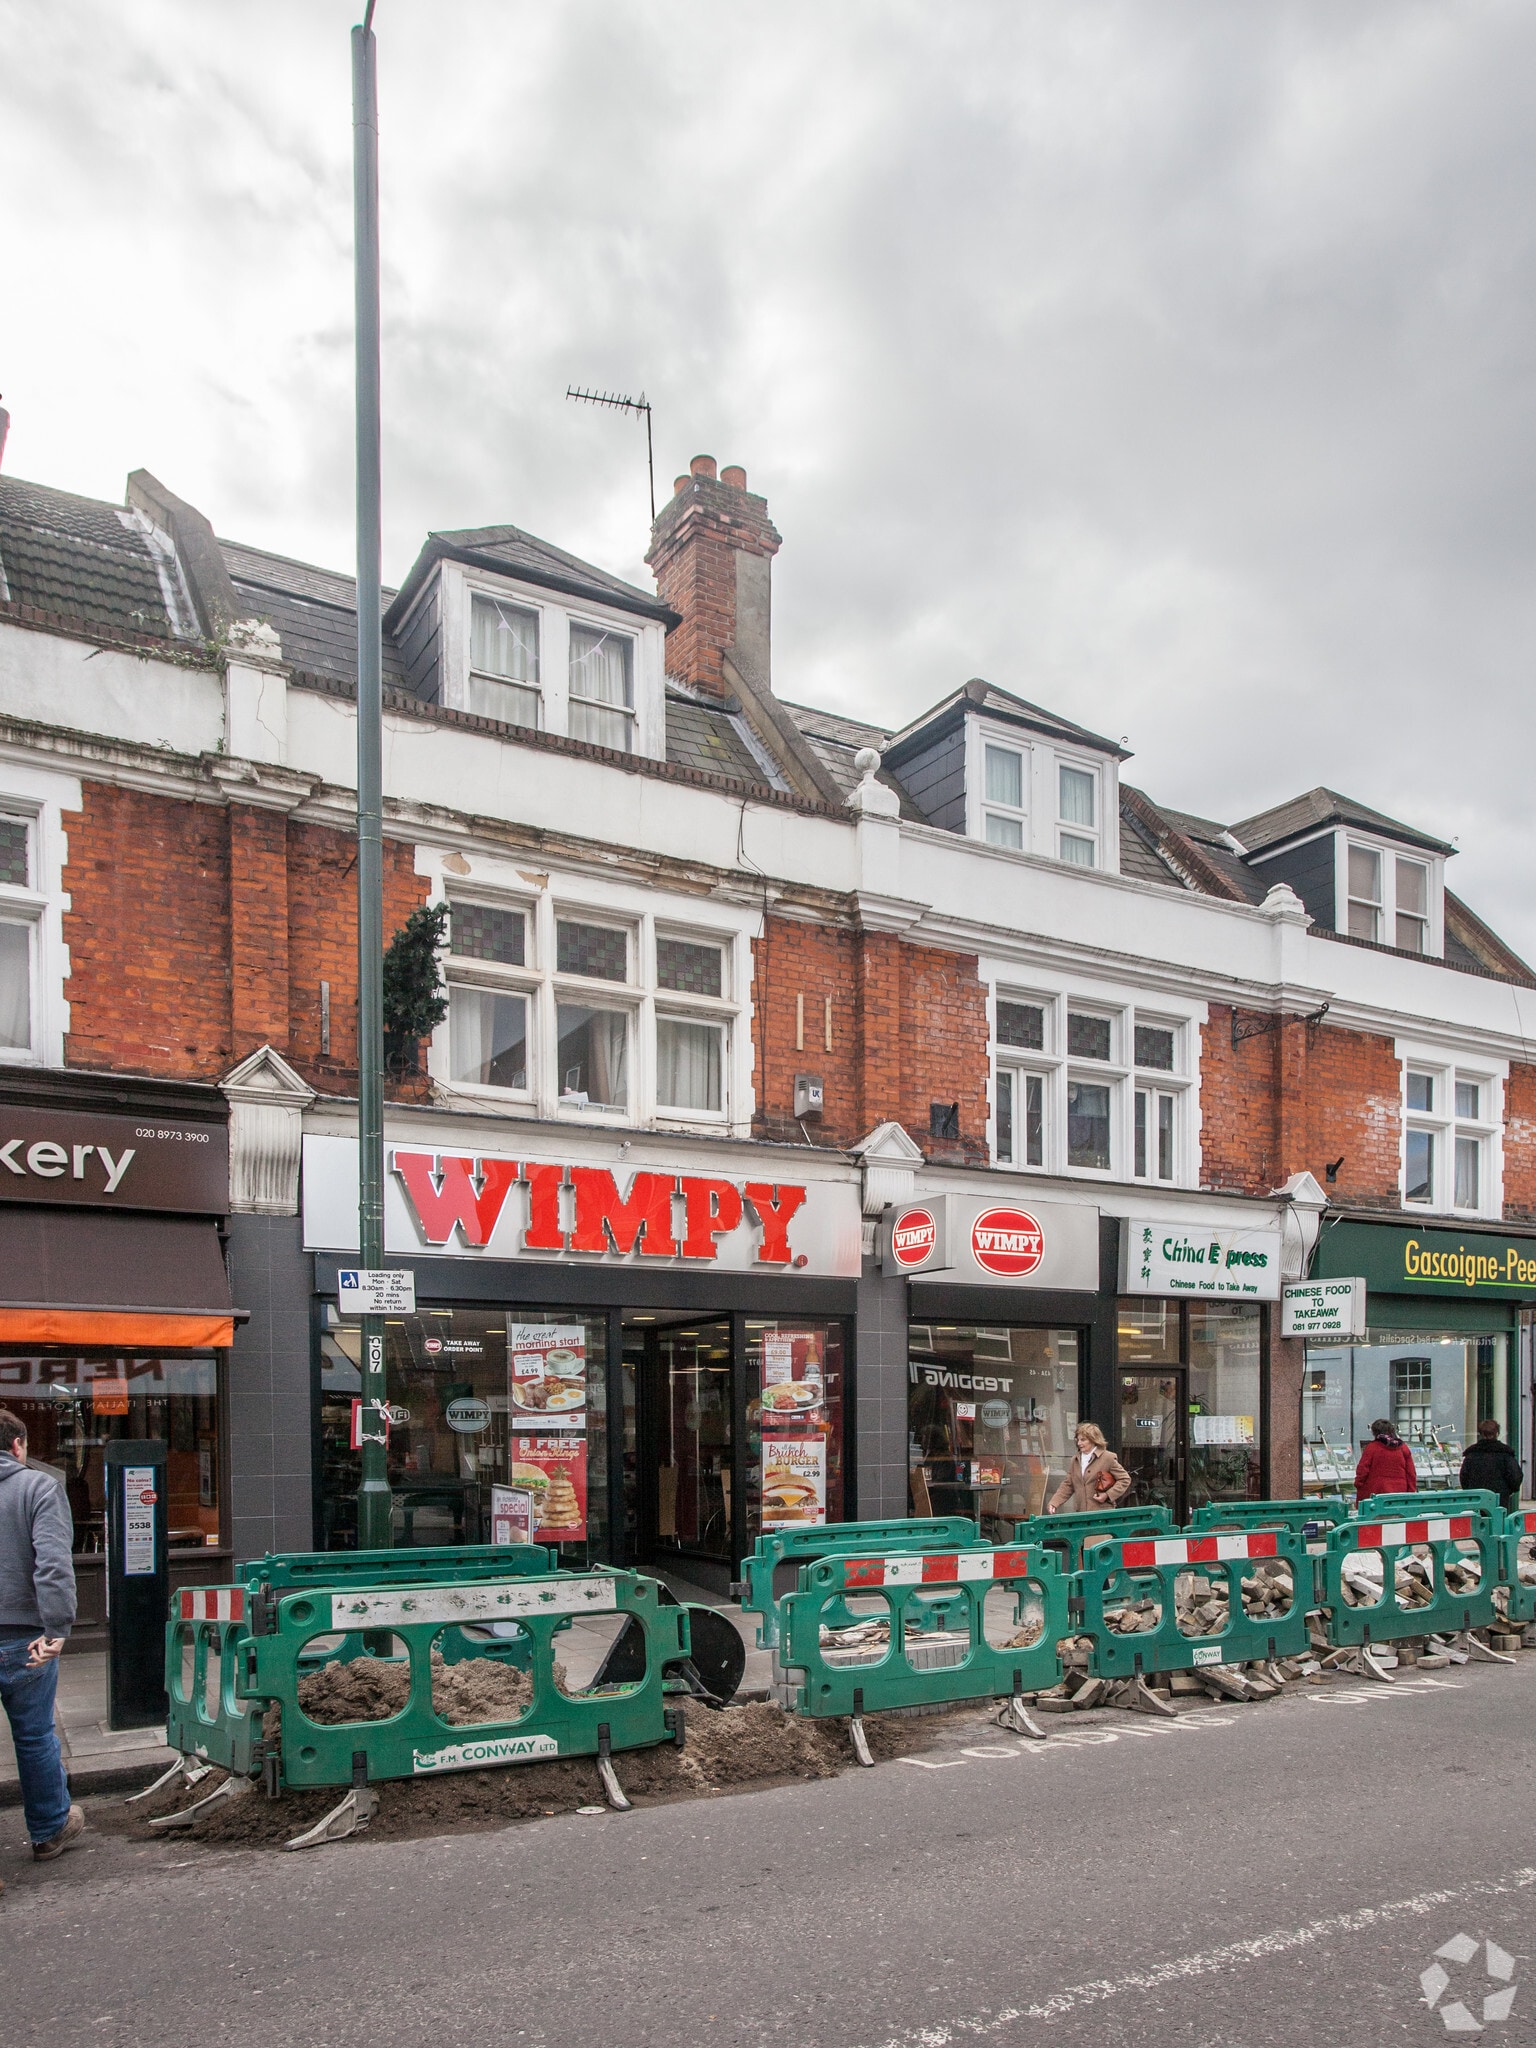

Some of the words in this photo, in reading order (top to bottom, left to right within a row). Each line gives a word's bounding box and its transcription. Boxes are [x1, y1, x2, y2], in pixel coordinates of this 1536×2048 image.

[135, 1128, 155, 1138] 020
[157, 1129, 183, 1141] 8973
[184, 1131, 210, 1143] 3900
[895, 1226, 934, 1248] WIMPY
[974, 1231, 1041, 1253] WIMPY
[1162, 1237, 1205, 1264] China
[1169, 1278, 1196, 1289] Chinese
[1199, 1280, 1215, 1290] Food
[1218, 1282, 1225, 1291] to
[1226, 1282, 1240, 1292] Take
[1242, 1282, 1258, 1294] Away
[1284, 1287, 1322, 1299] CHINESE
[1325, 1285, 1352, 1296] FOOD
[1311, 1298, 1325, 1307] TO
[1294, 1307, 1339, 1319] TAKEAWAY
[1292, 1323, 1305, 1331] 081
[1307, 1322, 1321, 1330] 977
[1322, 1320, 1342, 1330] 0928
[516, 1326, 531, 1341] the
[532, 1327, 558, 1341] great
[515, 1338, 557, 1350] morning
[559, 1336, 580, 1347] start
[521, 1367, 539, 1375] £4.99
[447, 1410, 490, 1420] WIMPY
[536, 1439, 580, 1449] FREE
[767, 1441, 809, 1458] Brunch
[519, 1447, 548, 1457] Onion
[548, 1447, 580, 1461] Rings
[775, 1455, 819, 1466] BURGER
[803, 1470, 820, 1478] £2.99
[500, 1500, 527, 1516] special
[128, 1521, 152, 1530] 5538
[1308, 1677, 1464, 1706] ONLY
[440, 1755, 458, 1764] F.M.
[462, 1740, 536, 1761] CONWAY
[539, 1743, 556, 1752] LTD
